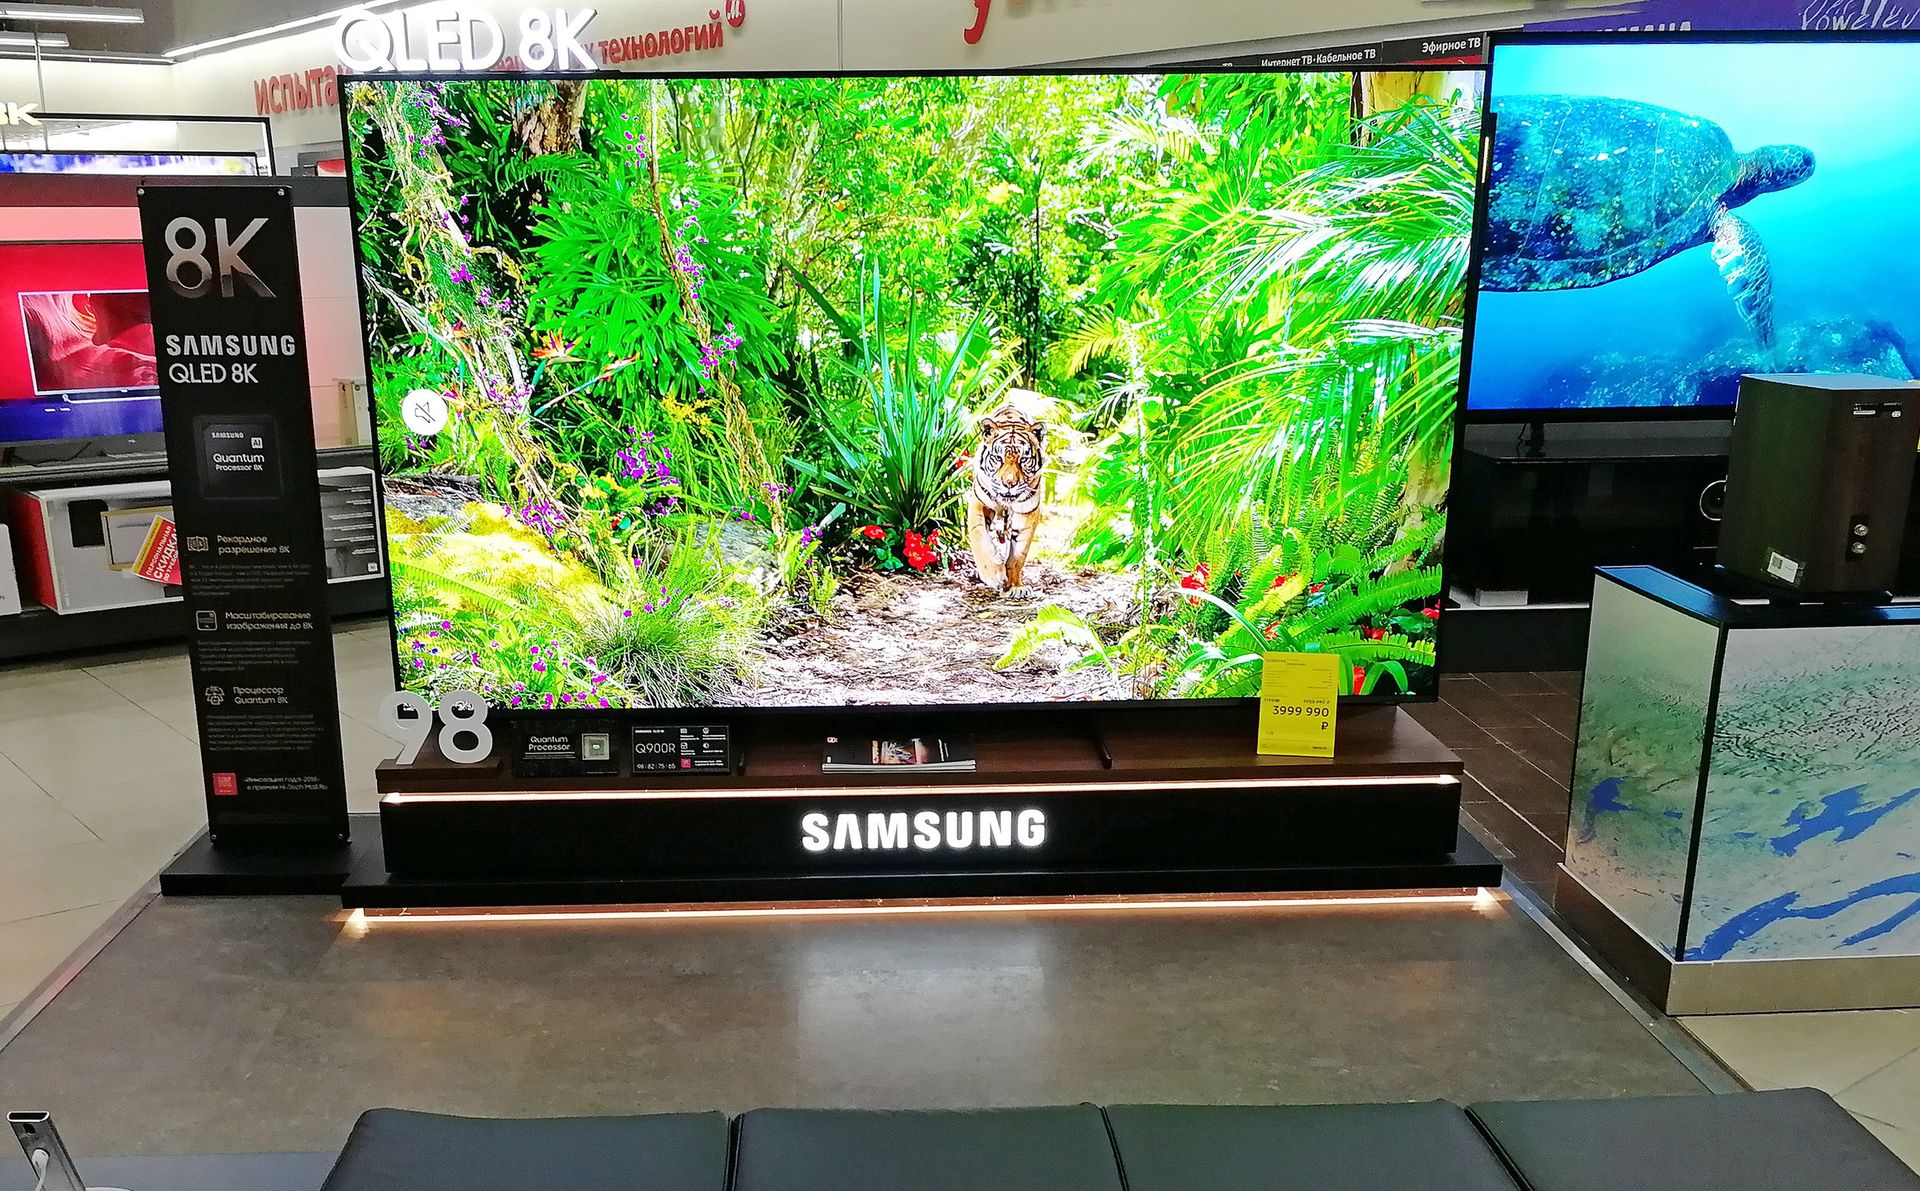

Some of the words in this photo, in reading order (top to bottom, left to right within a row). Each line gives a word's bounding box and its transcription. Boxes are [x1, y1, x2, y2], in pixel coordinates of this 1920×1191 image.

[332, 8, 505, 72] QLED
[518, 7, 598, 72] 8K
[598, 9, 723, 65] технологий
[1364, 48, 1376, 59] ТВ
[1422, 41, 1466, 55] Эфирное
[1468, 37, 1481, 48] ТВ
[253, 65, 353, 115] испыта
[164, 216, 277, 298] 8K
[165, 334, 296, 356] SAMSUNG
[168, 362, 227, 384] QLED
[231, 362, 259, 383] 8K
[212, 453, 265, 463] Quantum
[217, 535, 268, 545] Рекордное
[145, 525, 172, 576] ПЕРСОНАЛЬНАЯ
[218, 546, 277, 556] разрешение
[225, 612, 311, 621] Масштабирование
[226, 621, 288, 631] изображения
[289, 623, 301, 631] до
[233, 686, 284, 696] Процессор
[234, 697, 276, 705] Quantum
[277, 696, 288, 704] 8K
[1272, 705, 1302, 716] 3999
[1306, 707, 1330, 717] 990
[380, 690, 493, 765] 98
[635, 742, 676, 754] Q900R
[800, 808, 1047, 852] SAMSUNG
